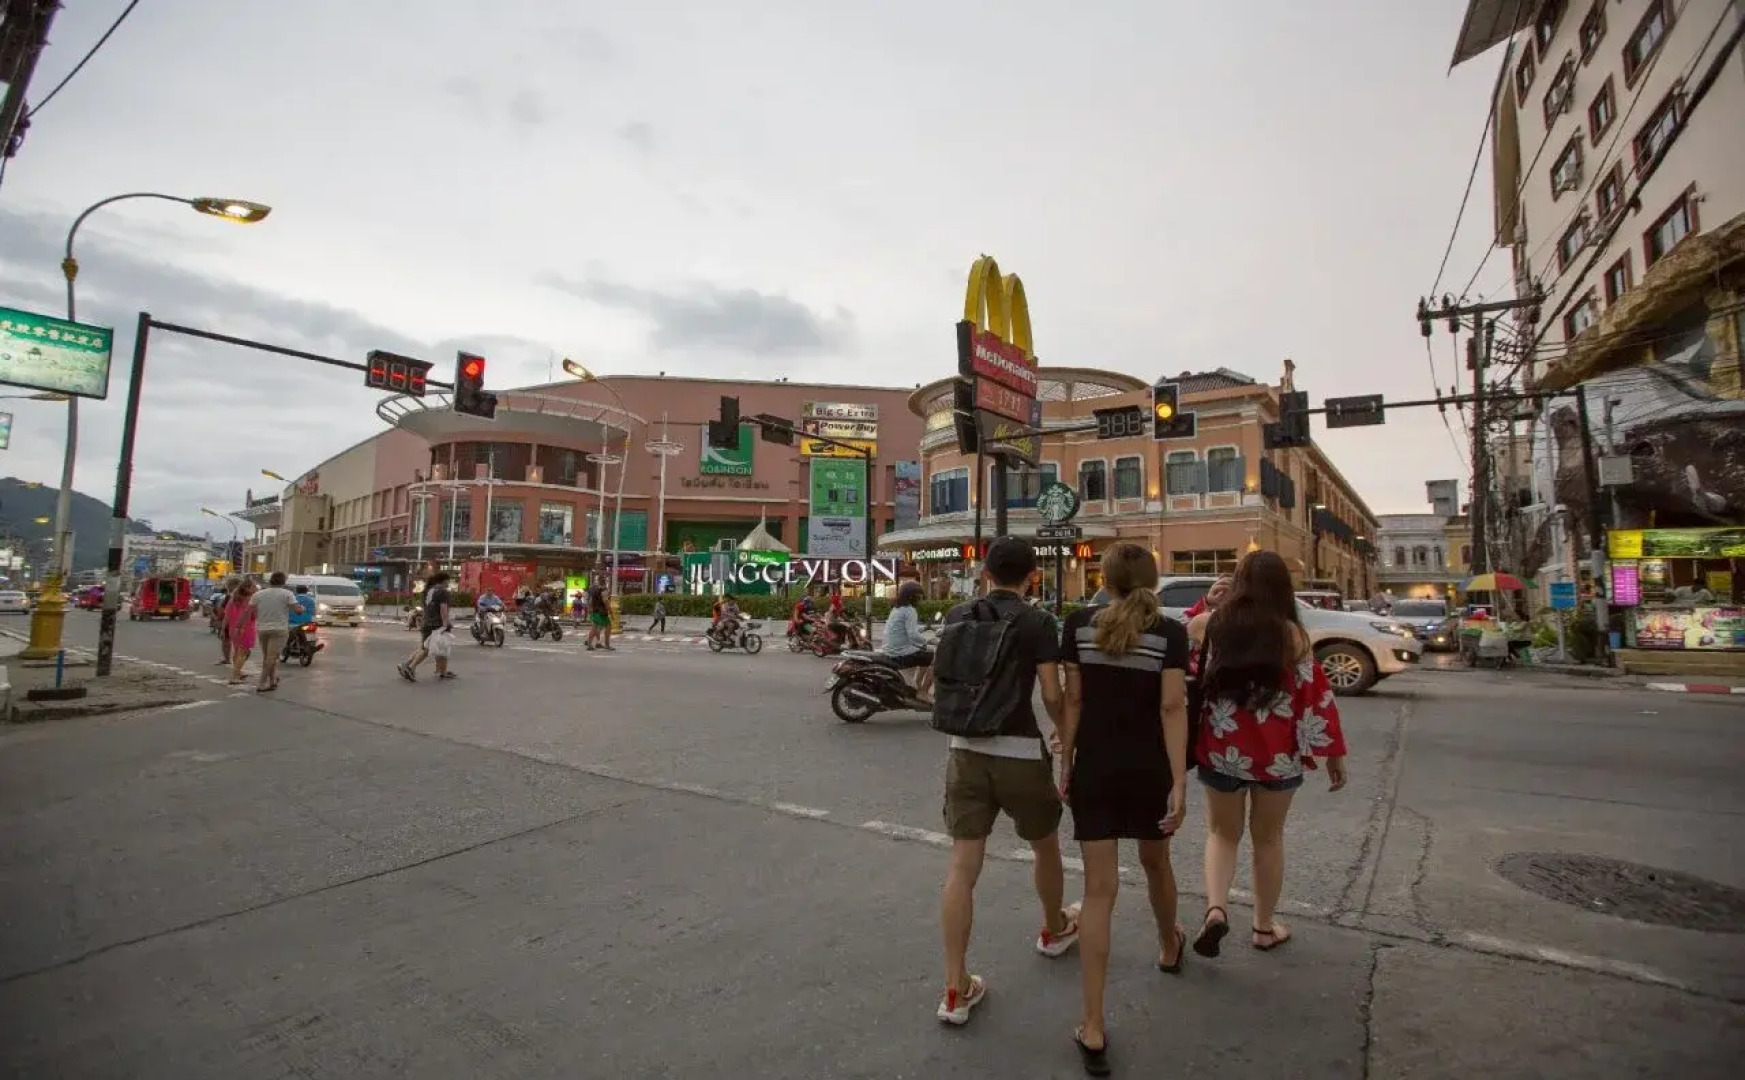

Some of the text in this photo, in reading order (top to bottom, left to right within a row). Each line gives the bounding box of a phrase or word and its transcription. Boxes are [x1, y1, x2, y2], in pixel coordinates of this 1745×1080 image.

[975, 345, 1037, 384] McDonald's
[816, 407, 875, 417] Big C Extra
[700, 464, 752, 474] ROBINSON
